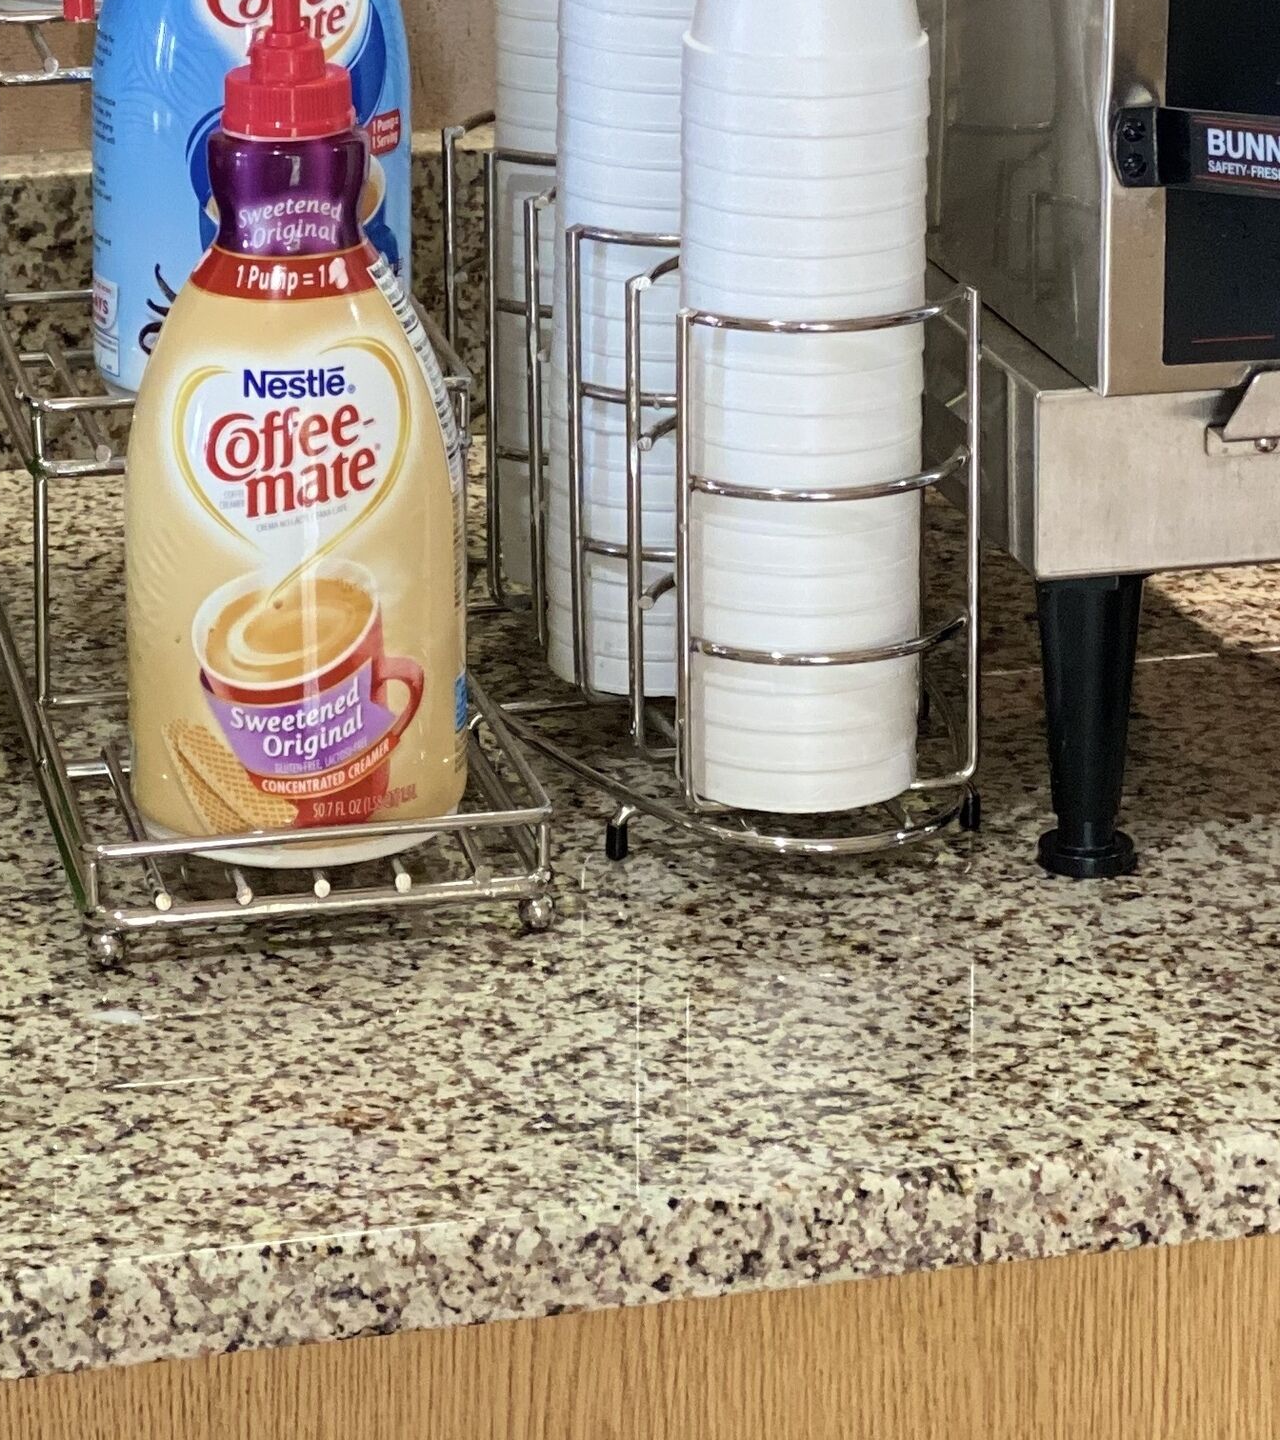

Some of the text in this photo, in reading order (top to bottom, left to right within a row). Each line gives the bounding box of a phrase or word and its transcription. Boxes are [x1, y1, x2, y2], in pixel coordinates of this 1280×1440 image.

[238, 198, 342, 229] Sweetened
[250, 218, 337, 249] Original
[236, 264, 245, 288] 1
[318, 264, 325, 288] 1
[243, 366, 346, 400] Nestlé
[245, 446, 376, 518] mate
[230, 676, 360, 733] Sweetened
[262, 703, 364, 760] Original
[261, 738, 390, 794] CONCENTRATED CREAMER
[335, 799, 347, 816] FL
[348, 798, 362, 815] OZ
